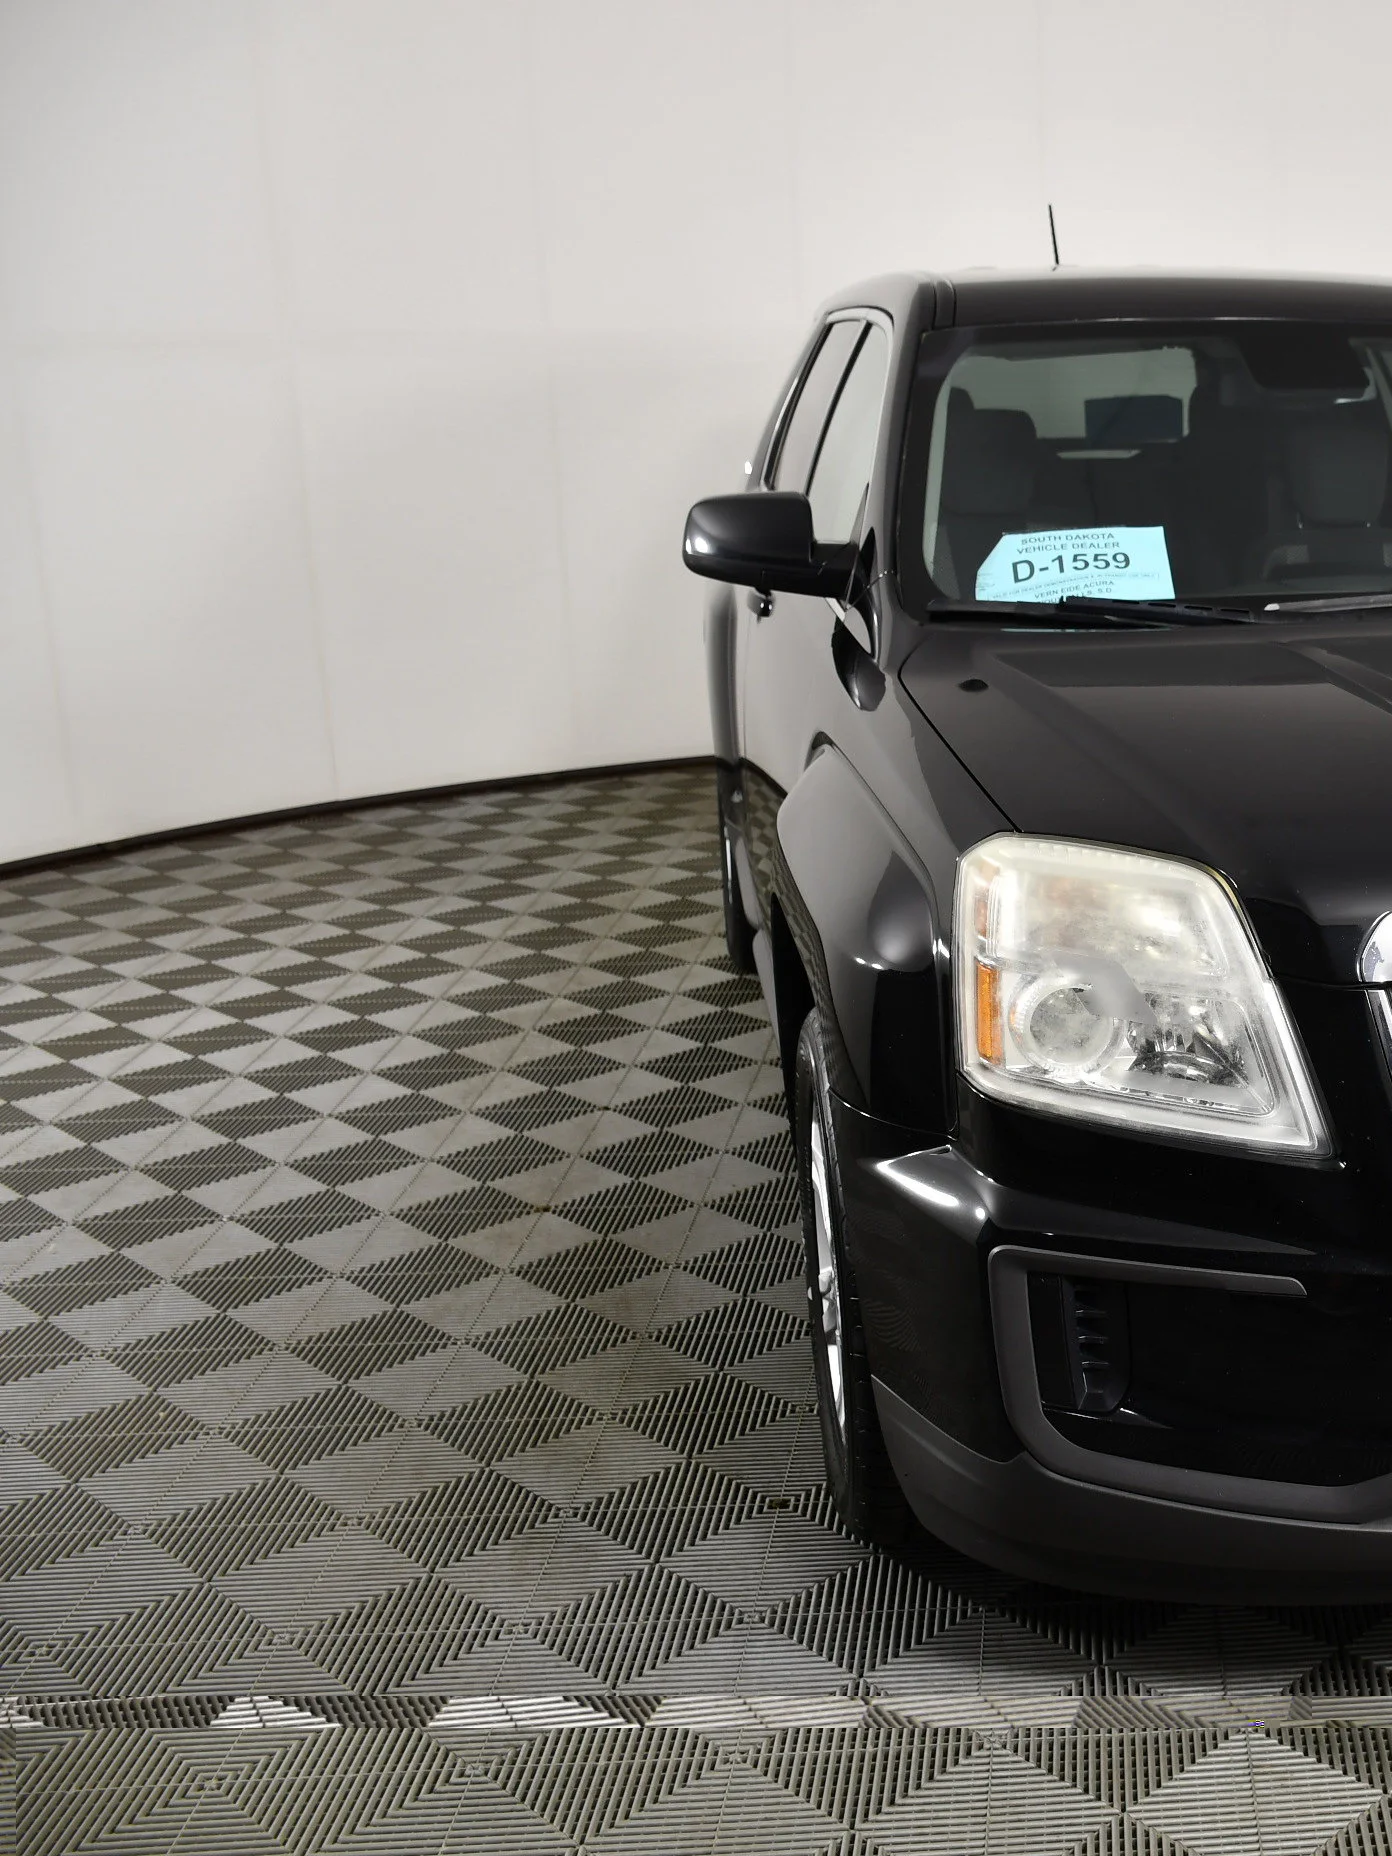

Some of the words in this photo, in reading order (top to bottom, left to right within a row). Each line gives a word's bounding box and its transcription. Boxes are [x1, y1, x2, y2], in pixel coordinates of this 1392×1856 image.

[1021, 535, 1062, 546] SOUTH
[1065, 532, 1115, 541] DAKOTA
[1016, 543, 1068, 555] VEHICLE
[1071, 541, 1121, 550] DEALER
[1011, 552, 1131, 584] D-1559
[1034, 590, 1059, 599] VERN
[1060, 584, 1081, 594] EIDE
[1083, 580, 1115, 589] ACURA
